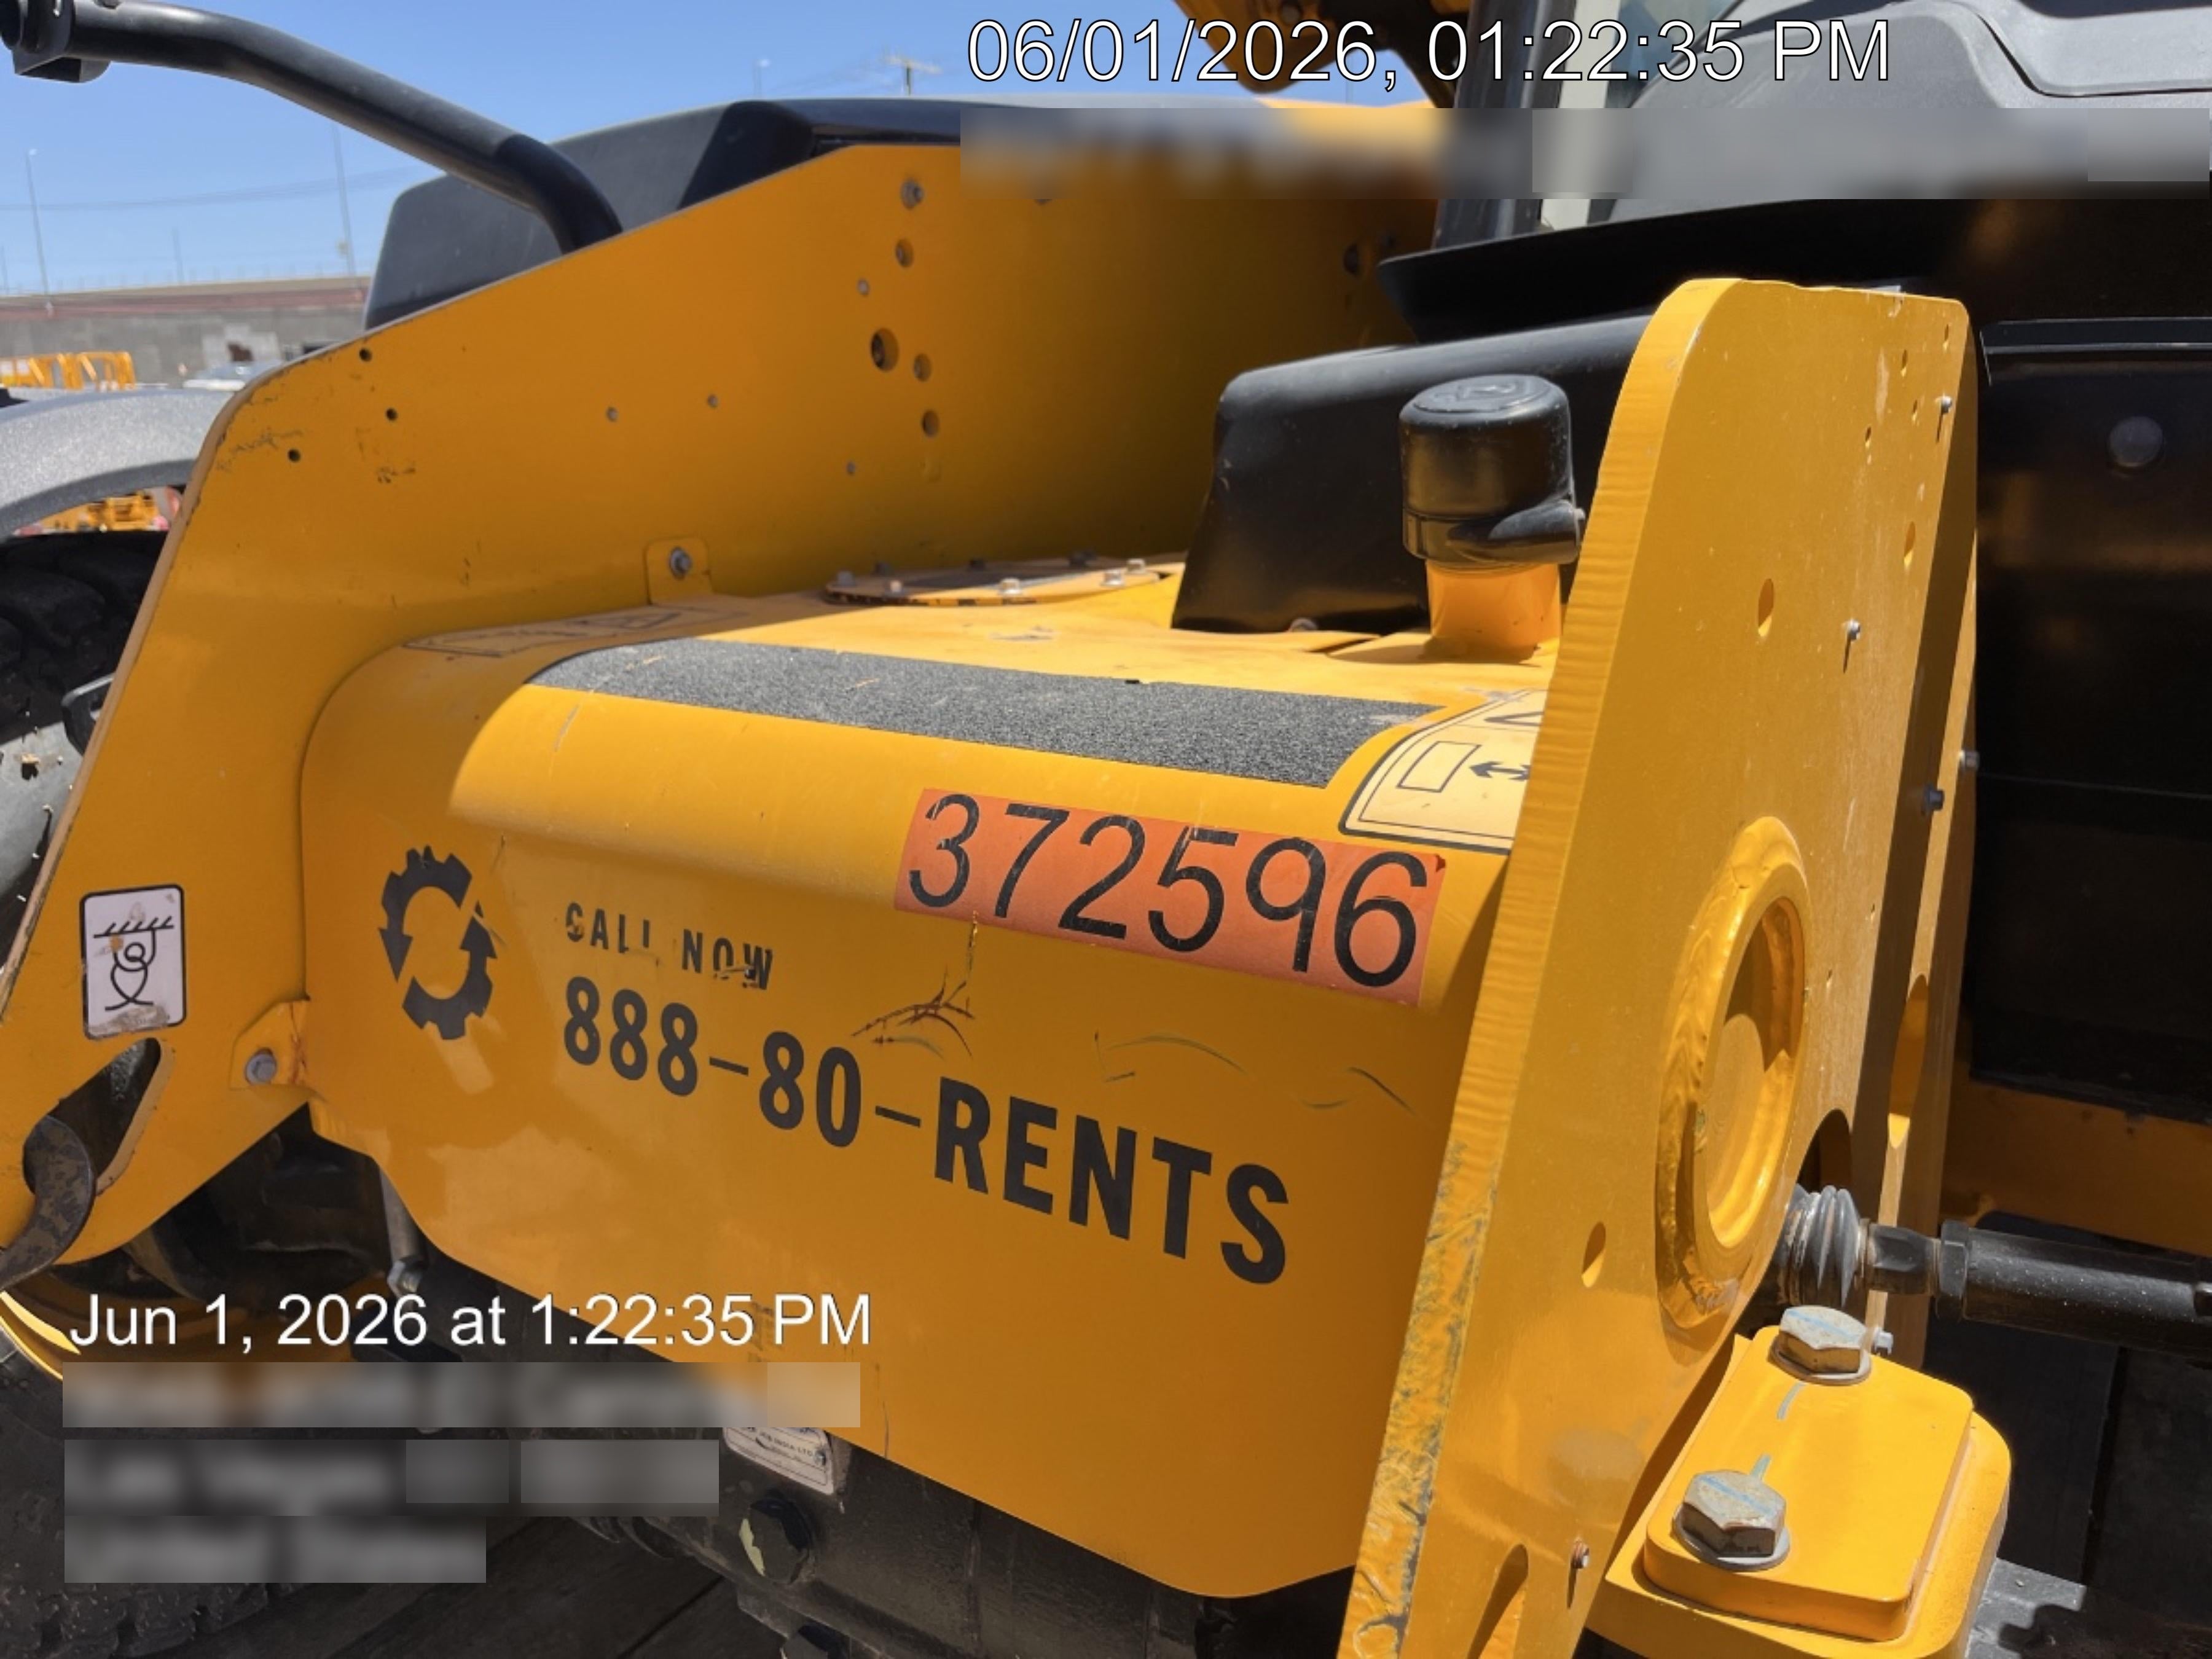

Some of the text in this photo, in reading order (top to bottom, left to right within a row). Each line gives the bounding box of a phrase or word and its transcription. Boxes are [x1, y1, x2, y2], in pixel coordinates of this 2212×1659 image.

[681, 928, 773, 990] NOW
[909, 794, 1429, 987] 372596
[563, 976, 1290, 1285] 888-80-RENTS
